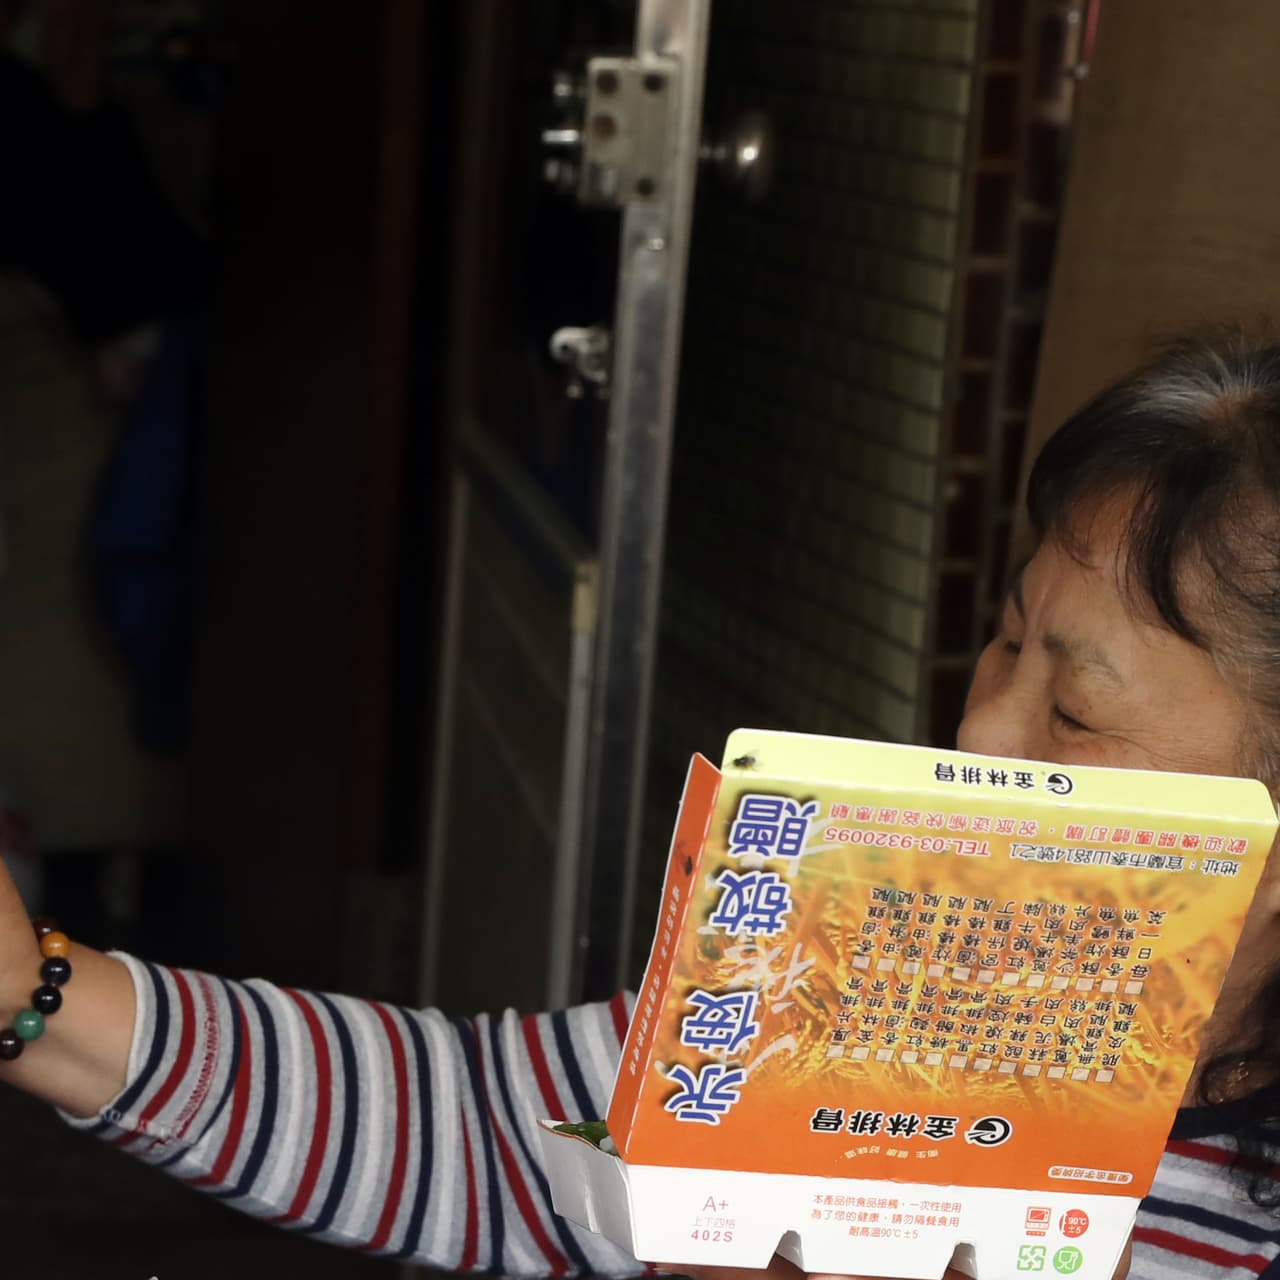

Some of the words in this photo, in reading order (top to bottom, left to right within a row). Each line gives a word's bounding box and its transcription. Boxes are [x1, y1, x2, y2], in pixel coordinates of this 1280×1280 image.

[935, 763, 1035, 783] 金林排骨
[822, 826, 991, 856] TEL:03-9320095
[855, 887, 891, 953] 香滷雞腿
[880, 890, 917, 956] 油淋雞腿
[930, 895, 968, 962] 炸棒棒腿
[979, 898, 1018, 967] 宮保雞丁
[1004, 901, 1043, 968] 紅燒牛腩
[1054, 905, 1093, 973] 沙茶羊肉片
[1102, 909, 1142, 976] 香酥鮮魚
[1127, 910, 1167, 977] 每日一菜
[829, 976, 865, 1043] 厚片排骨
[853, 979, 890, 1044] 金林排骨
[878, 981, 915, 1046] 香滷排骨
[927, 986, 964, 1050] 糖醋排骨
[952, 989, 989, 1053] 黑椒排骨
[1001, 994, 1039, 1058] 酸辣豬手
[1074, 999, 1112, 1064] 無骨雞腿排
[1098, 1001, 1137, 1066] 脆皮雞腿
[809, 1107, 958, 1139] 金林排骨
[691, 1230, 733, 1242] 402S
[702, 1196, 729, 1212] A+
